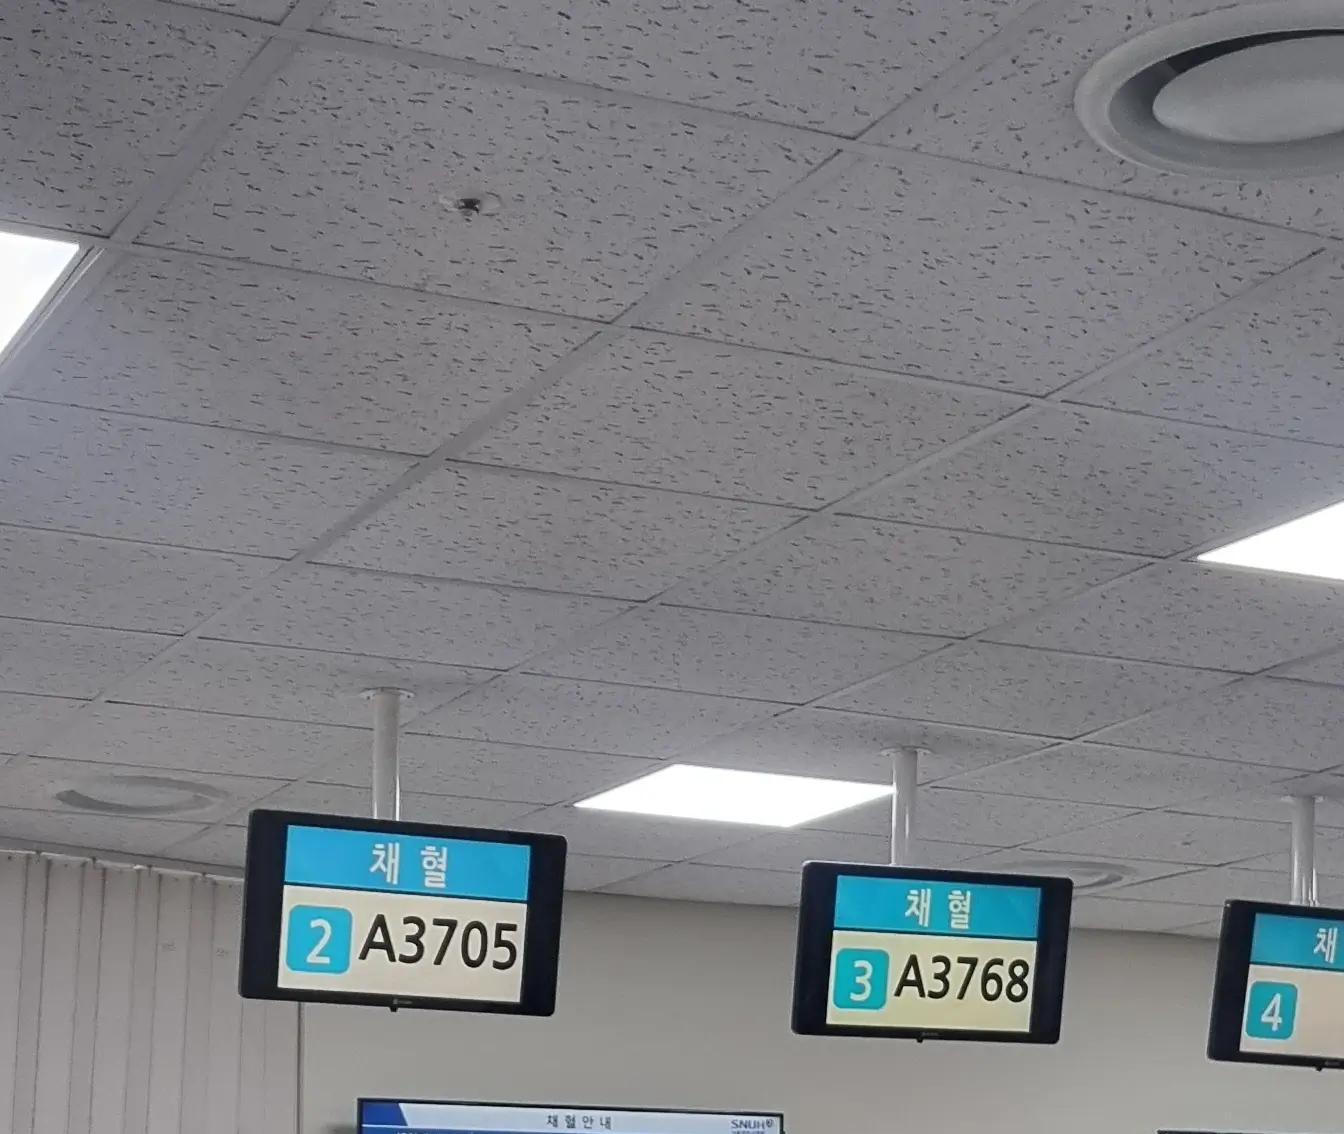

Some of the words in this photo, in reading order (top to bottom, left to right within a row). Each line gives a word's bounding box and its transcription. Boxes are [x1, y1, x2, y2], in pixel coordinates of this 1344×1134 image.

[308, 919, 330, 964] 2
[358, 914, 518, 970] A3705
[848, 959, 872, 1003] 3
[894, 955, 1029, 1005] A3768
[1260, 994, 1284, 1031] 4
[731, 1119, 766, 1130] SNUH
